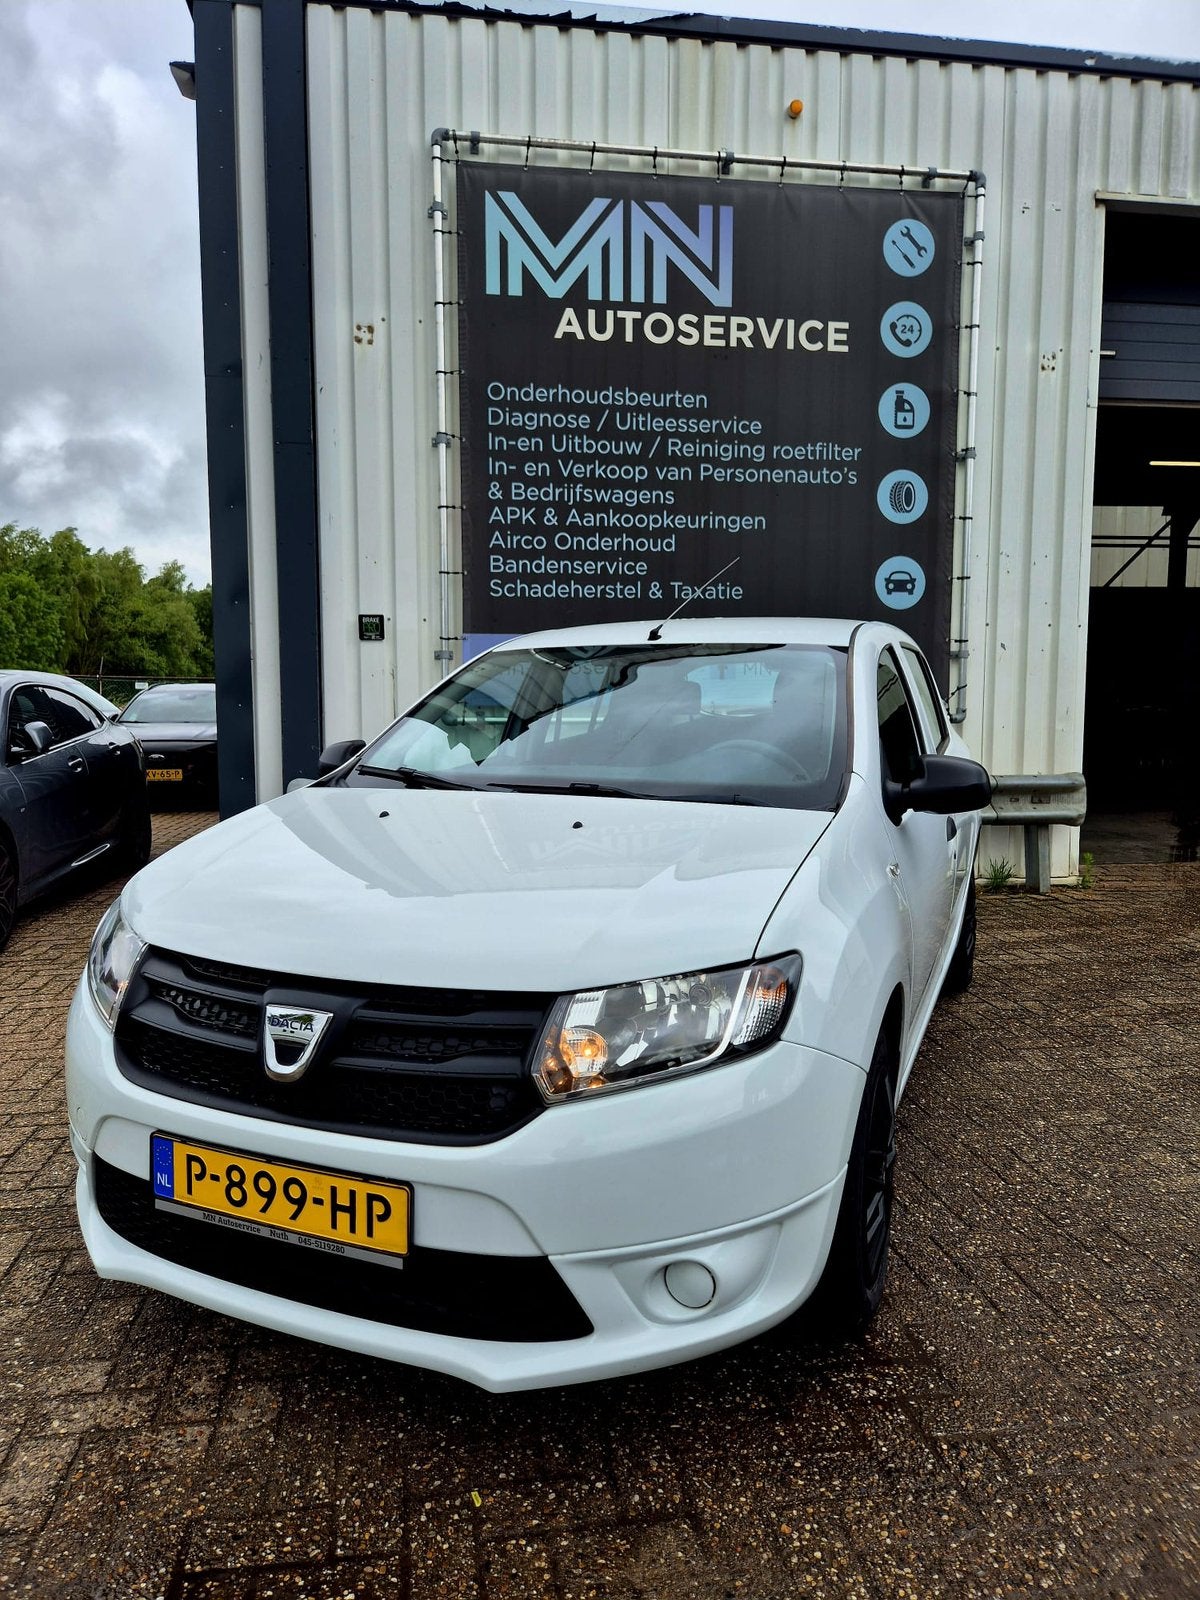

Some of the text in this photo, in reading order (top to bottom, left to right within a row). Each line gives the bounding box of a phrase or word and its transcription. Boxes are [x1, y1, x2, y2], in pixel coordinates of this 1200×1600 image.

[485, 190, 733, 307] MN
[554, 307, 849, 352] AUTOSERVICE
[900, 324, 915, 334] 24
[487, 382, 708, 409] Onderhoudsbeurten
[487, 407, 763, 435] Diagnose / Uitleesservice
[488, 432, 863, 462] In-en Uitbouw / Reiniging roetfilter
[488, 457, 858, 485] In- en Verkoop van Personenauto's
[488, 481, 676, 507] & Bedrijfswagens
[488, 506, 767, 533] APK & Aankoopkeuringen
[489, 531, 676, 552] Airco Onderhoud
[490, 555, 648, 575] Bandenservice
[490, 579, 744, 600] Schadeherstel & Taxatie
[269, 1016, 314, 1032] DACIA
[157, 1172, 171, 1188] NL
[186, 1153, 392, 1238] P-899-HP
[202, 1212, 345, 1254] MN Autoservice Nuth 045-5119280
